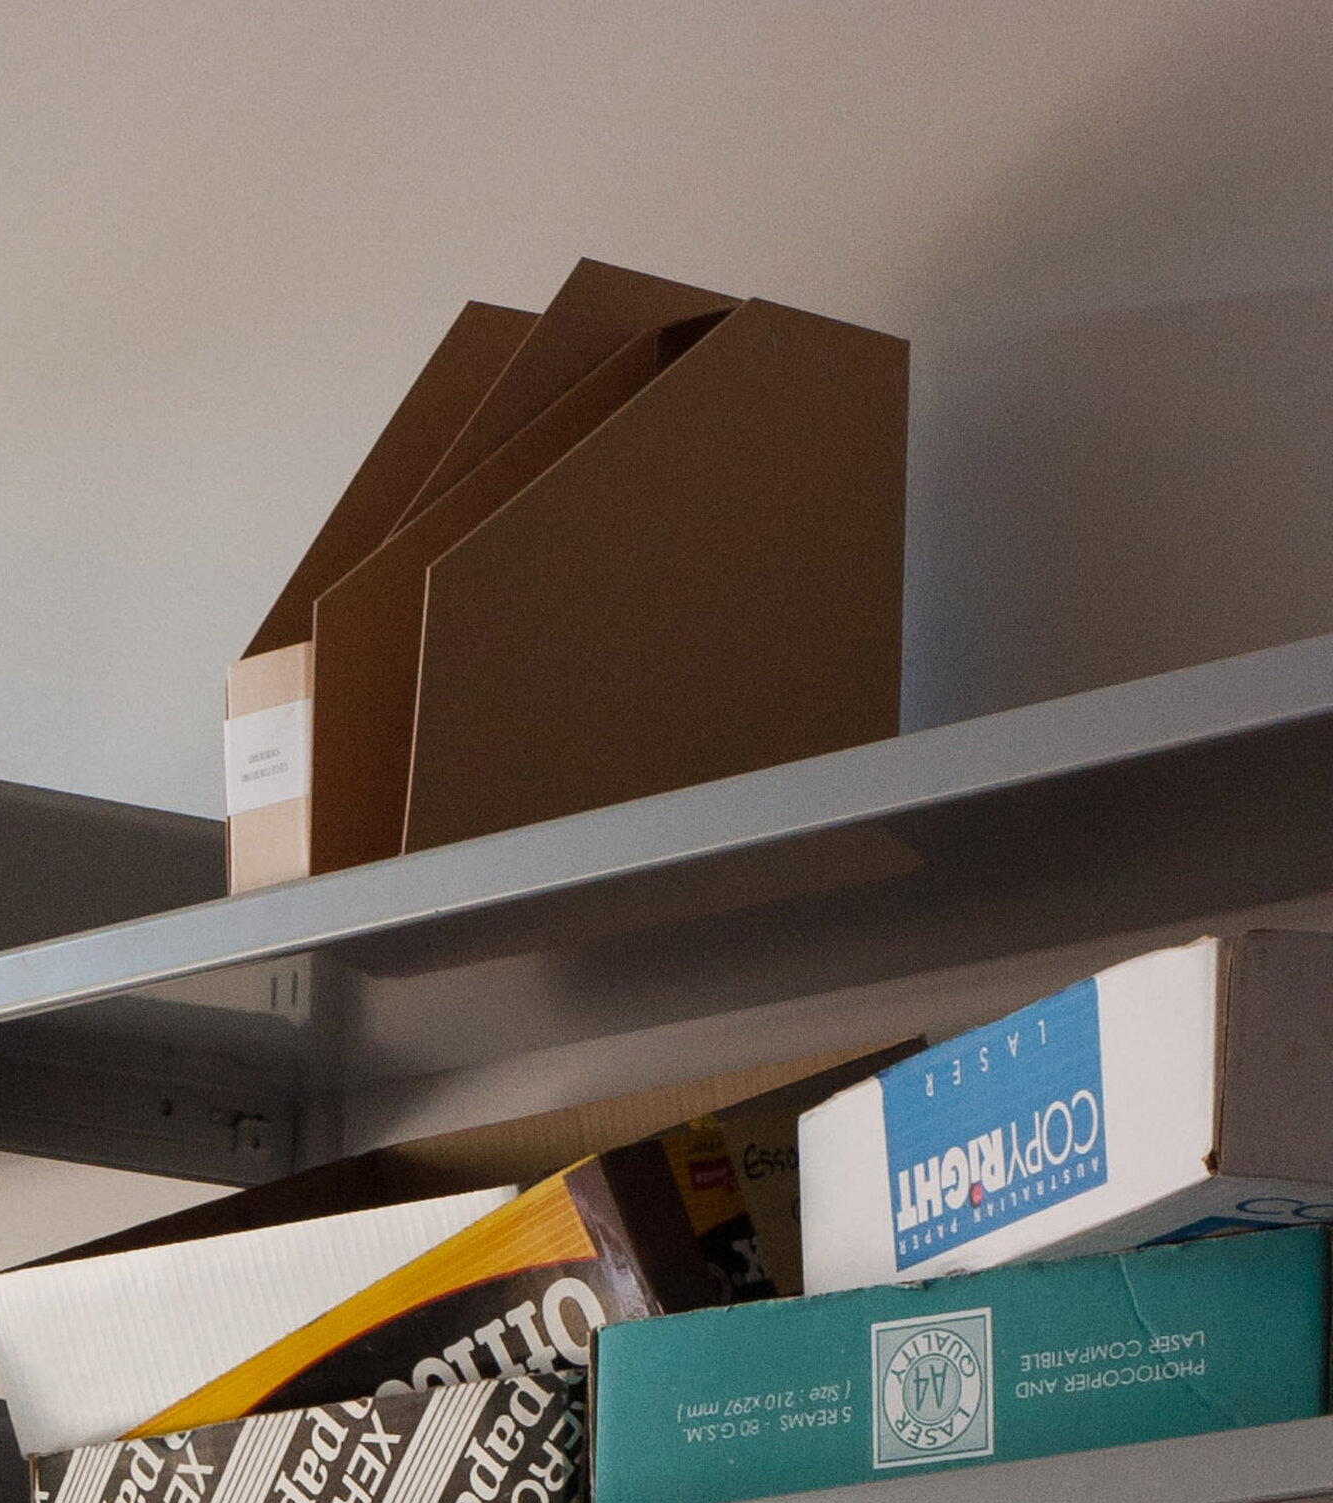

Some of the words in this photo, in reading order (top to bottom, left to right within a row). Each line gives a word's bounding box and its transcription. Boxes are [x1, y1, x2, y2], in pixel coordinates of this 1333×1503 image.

[925, 1018, 1046, 1098] LASER
[972, 1157, 1098, 1223] AUSTRALIAN
[898, 1218, 957, 1255] PAPER
[890, 1332, 976, 1385] QUALITY
[1020, 1339, 1143, 1372] COMPATIBLE
[1148, 1330, 1206, 1354] LASER
[913, 1362, 948, 1412] A4
[1015, 1377, 1059, 1399] AND
[1064, 1357, 1206, 1393] PHOTOCOPIER
[740, 1419, 760, 1437] 80
[780, 1408, 838, 1432] REAMS
[894, 1406, 971, 1446] LASER
